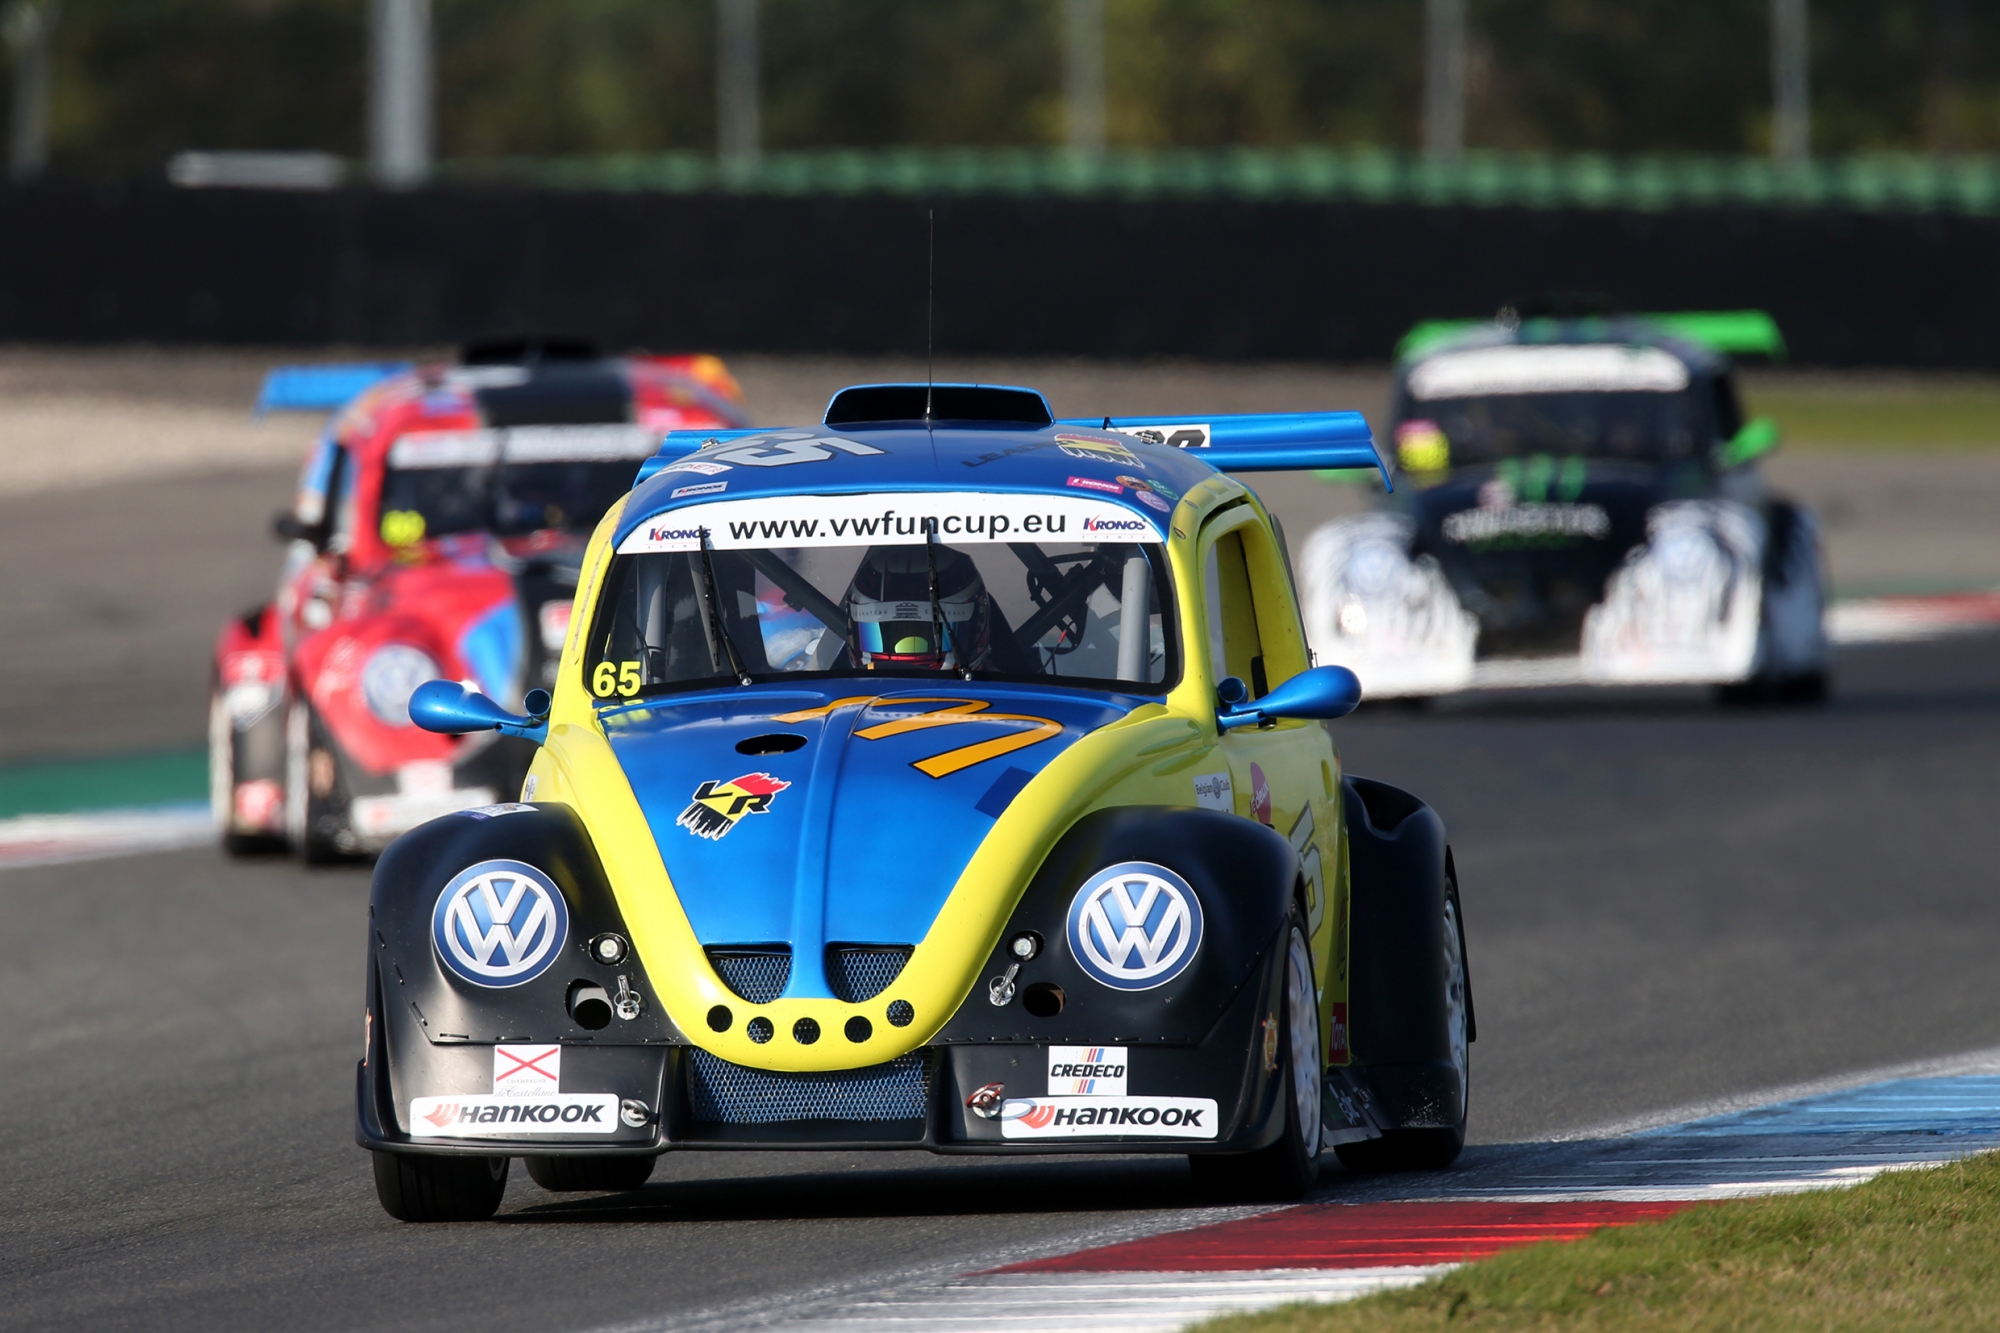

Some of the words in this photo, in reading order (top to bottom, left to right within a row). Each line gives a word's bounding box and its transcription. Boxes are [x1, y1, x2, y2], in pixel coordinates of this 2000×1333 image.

[649, 524, 712, 541] KRONOS
[729, 510, 1066, 540] www.vwfuncup.eu
[1083, 514, 1146, 532] KRONOS
[593, 661, 641, 697] 65
[1051, 1064, 1125, 1079] CREDECO
[505, 1085, 556, 1098] Castellane
[458, 1104, 605, 1124] HANKOOK
[1053, 1107, 1205, 1127] HANKOOK
